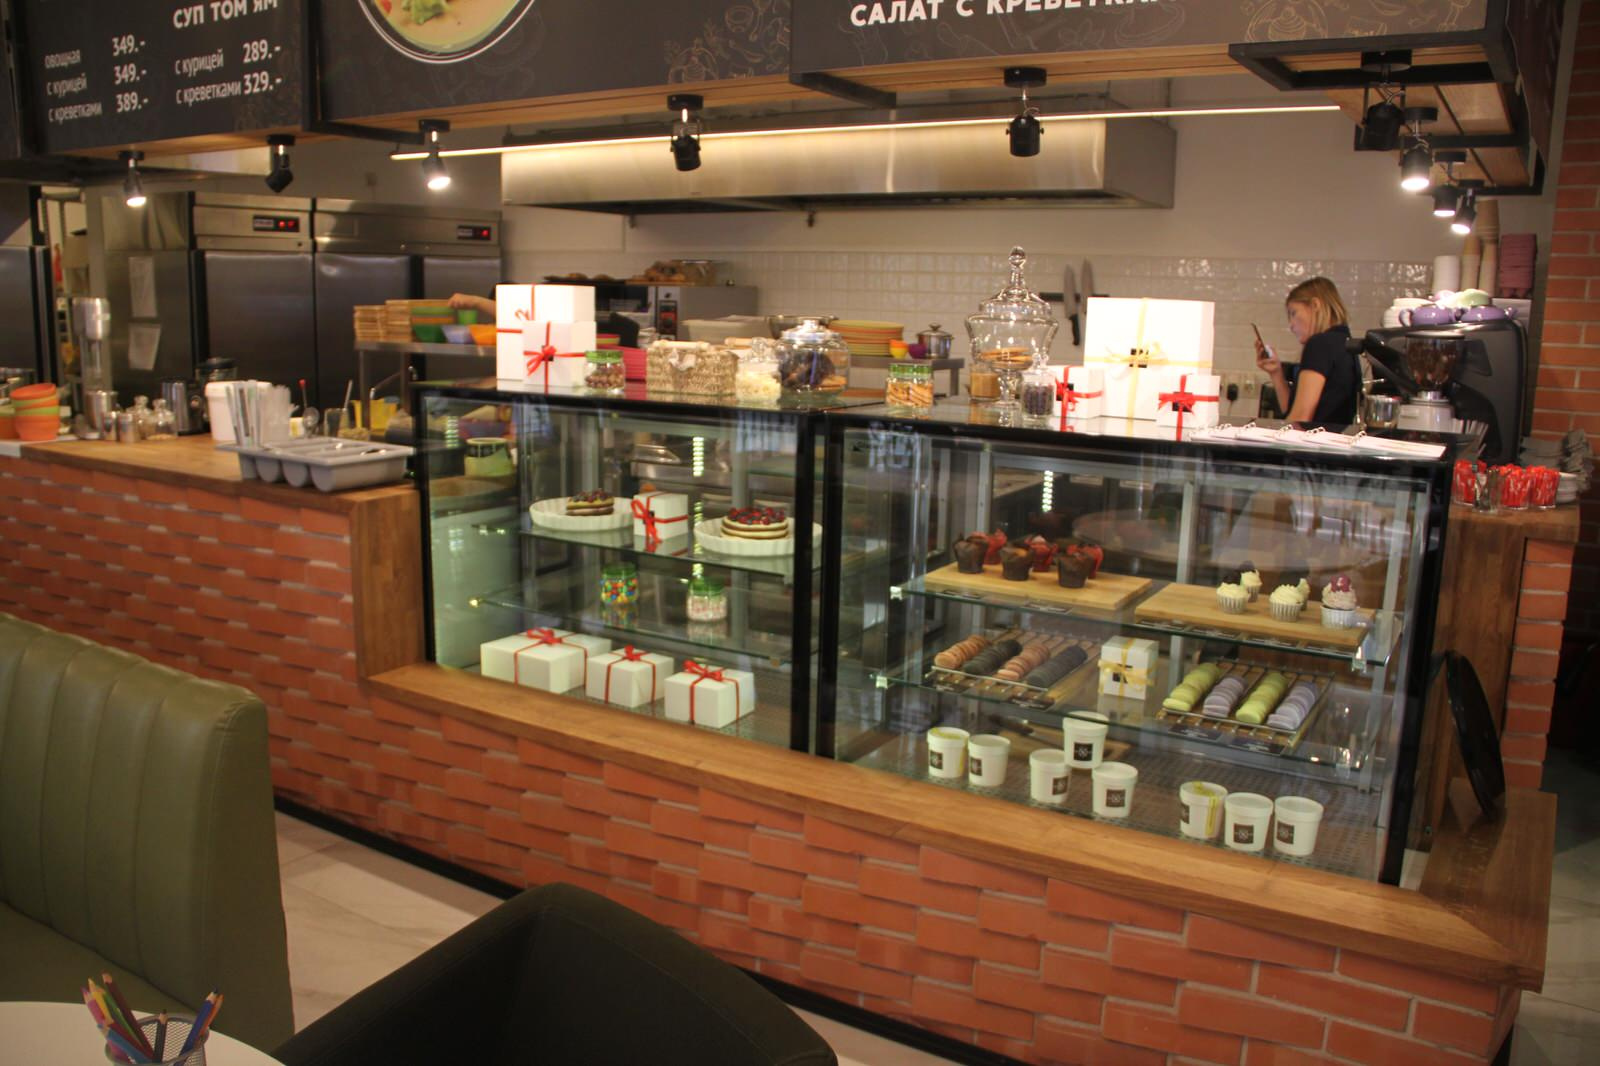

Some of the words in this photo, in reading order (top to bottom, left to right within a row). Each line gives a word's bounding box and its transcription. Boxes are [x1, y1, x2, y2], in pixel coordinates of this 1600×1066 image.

[173, 4, 205, 29] СУП
[209, 0, 247, 21] ТОМ
[850, 0, 945, 27] САЛАТ
[956, 0, 974, 17] С
[182, 48, 224, 78] курицей
[183, 81, 242, 107] креветками
